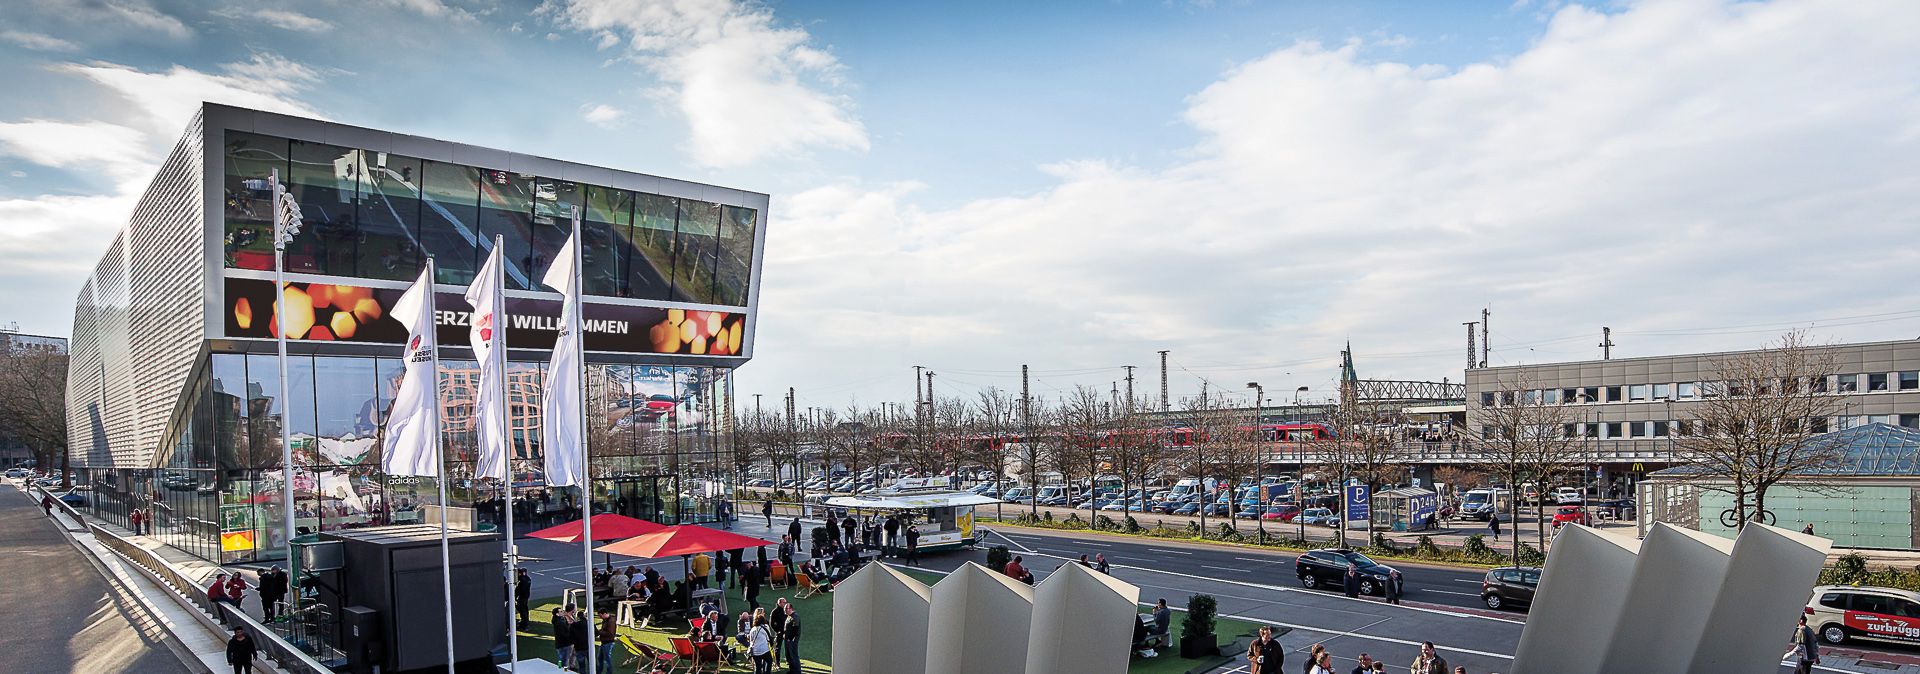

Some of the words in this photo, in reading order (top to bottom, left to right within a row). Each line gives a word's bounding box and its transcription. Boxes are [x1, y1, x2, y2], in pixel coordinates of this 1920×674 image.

[513, 314, 629, 334] WILLMMEN
[388, 476, 420, 484] adidas
[1355, 487, 1364, 500] P
